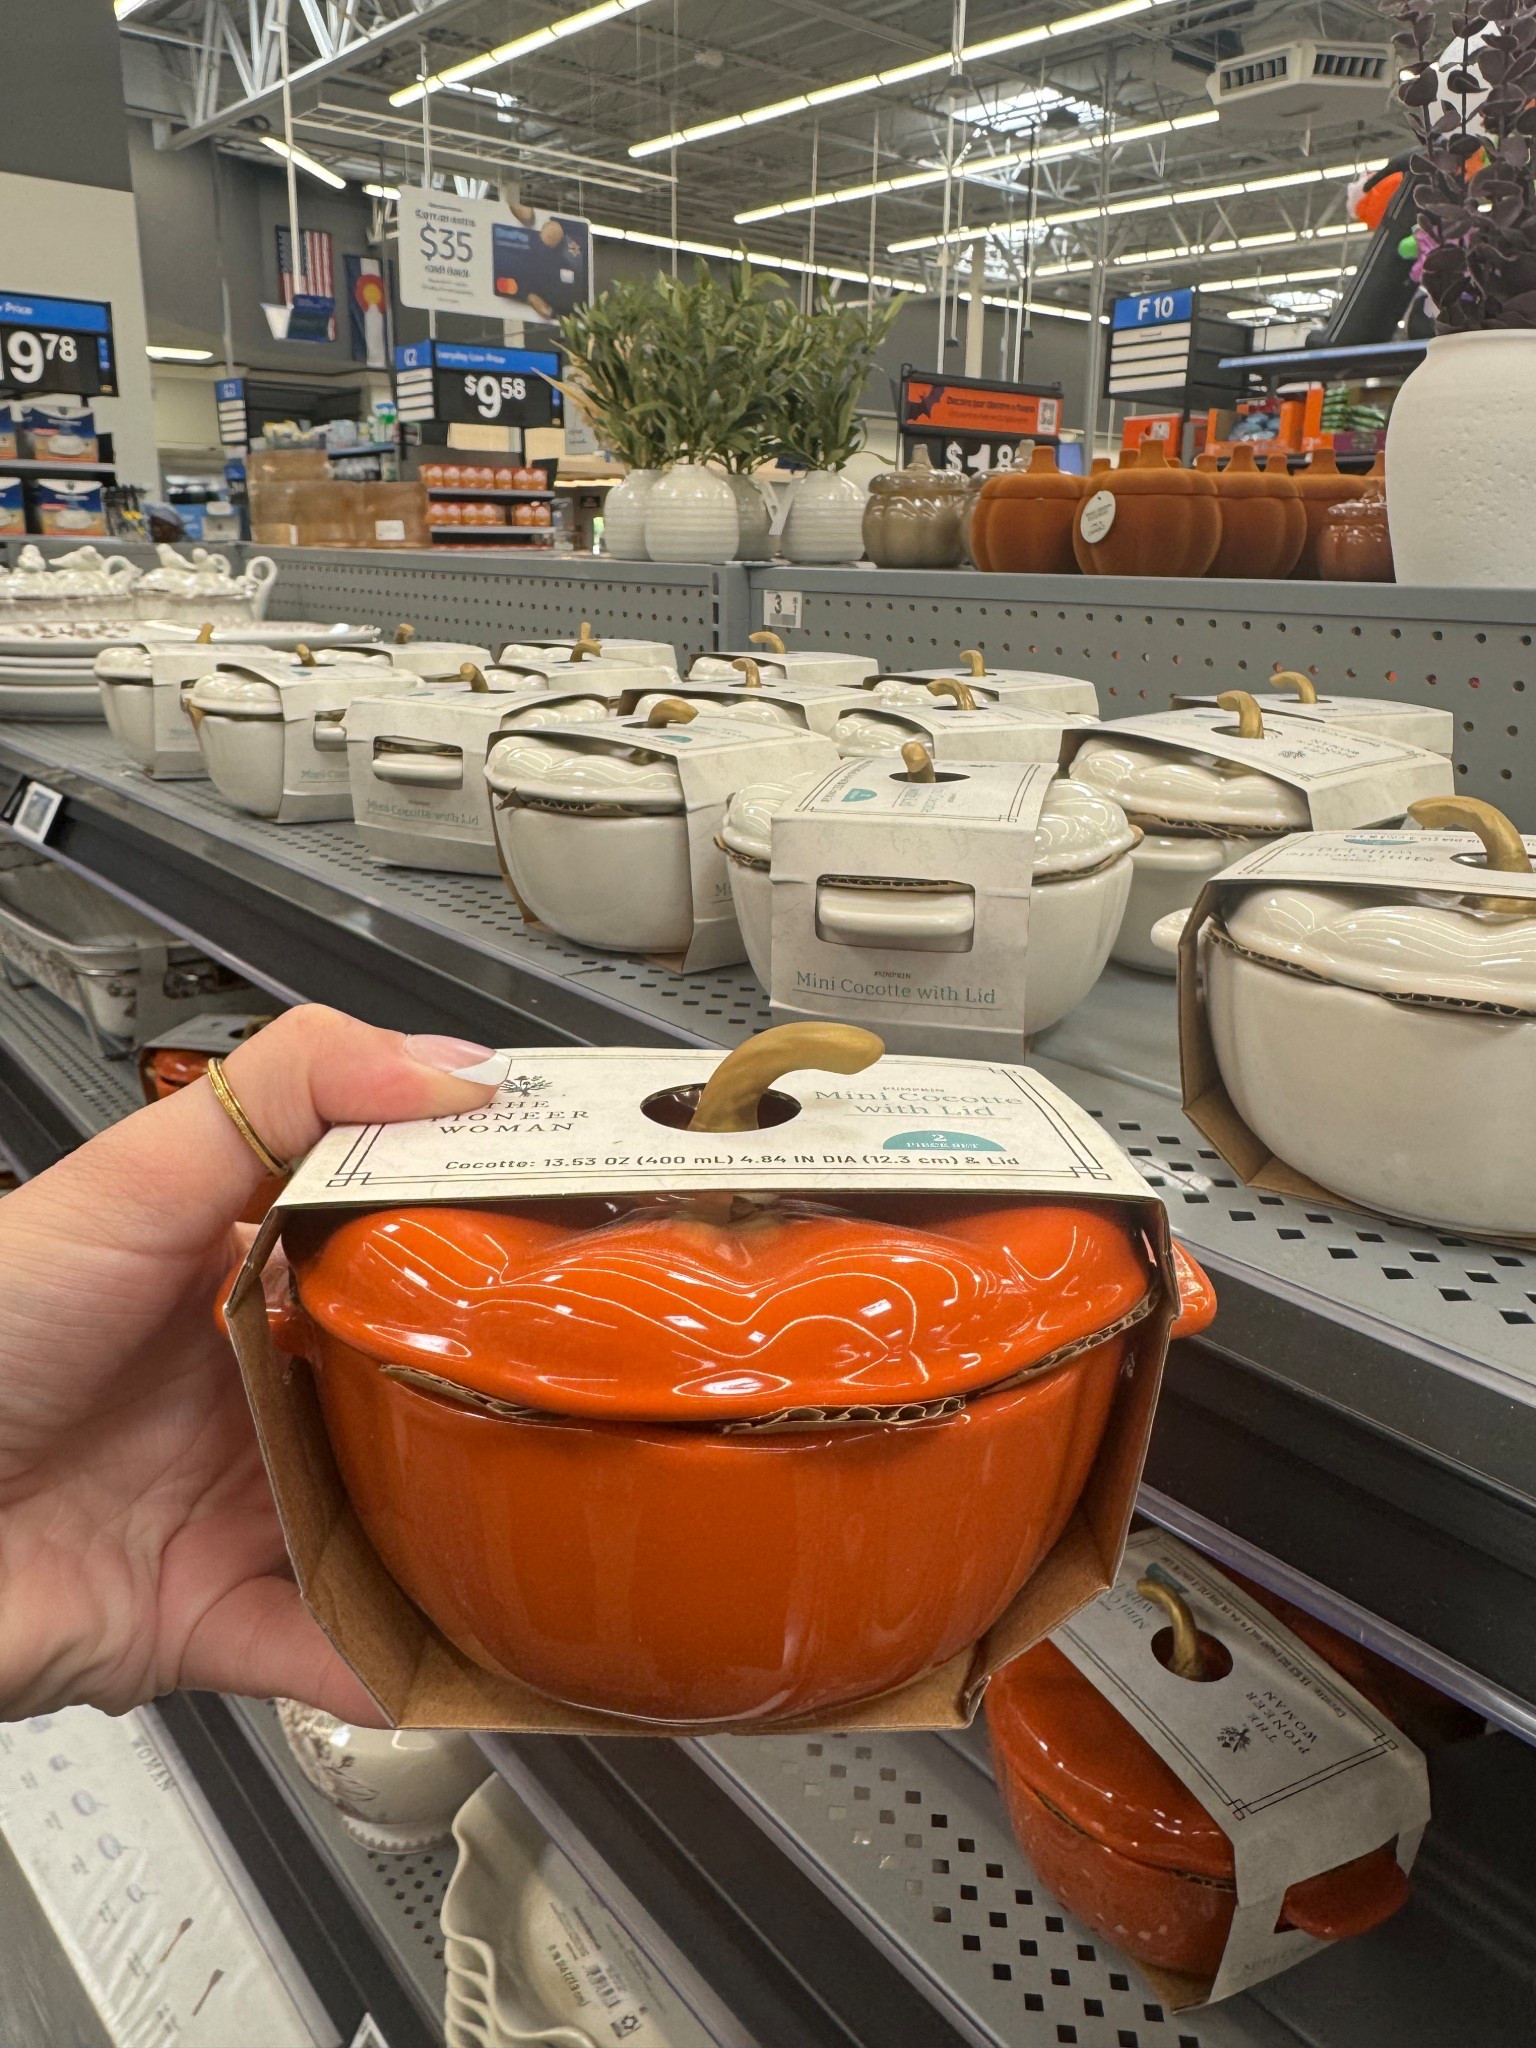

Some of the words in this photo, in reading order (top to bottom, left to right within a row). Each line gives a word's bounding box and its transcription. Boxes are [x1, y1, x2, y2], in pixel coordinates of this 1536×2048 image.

[420, 222, 473, 262] $35
[796, 971, 835, 991] Mini
[840, 979, 911, 998] Cocotte
[916, 985, 958, 1001] with
[966, 987, 995, 1004] Lid
[815, 1091, 889, 1100] Mini
[898, 1091, 1023, 1105] Cocotte
[854, 1103, 930, 1115] with
[941, 1105, 995, 1117] Lid
[439, 1122, 575, 1134] WOMAN
[445, 1161, 535, 1170] Cocotte:
[544, 1158, 597, 1168] 13.53
[604, 1156, 630, 1166] OZ
[636, 1155, 686, 1166] (400
[694, 1155, 734, 1165] mL)
[740, 1155, 787, 1165] 4.84
[795, 1155, 815, 1164] IN
[823, 1155, 857, 1164] DIA
[863, 1155, 910, 1165] (12.3
[918, 1156, 959, 1166] cm)
[965, 1156, 981, 1165] &
[988, 1156, 1020, 1166] Lid
[1246, 1691, 1311, 1754] PIONEER
[1263, 1691, 1318, 1744] WOMAN
